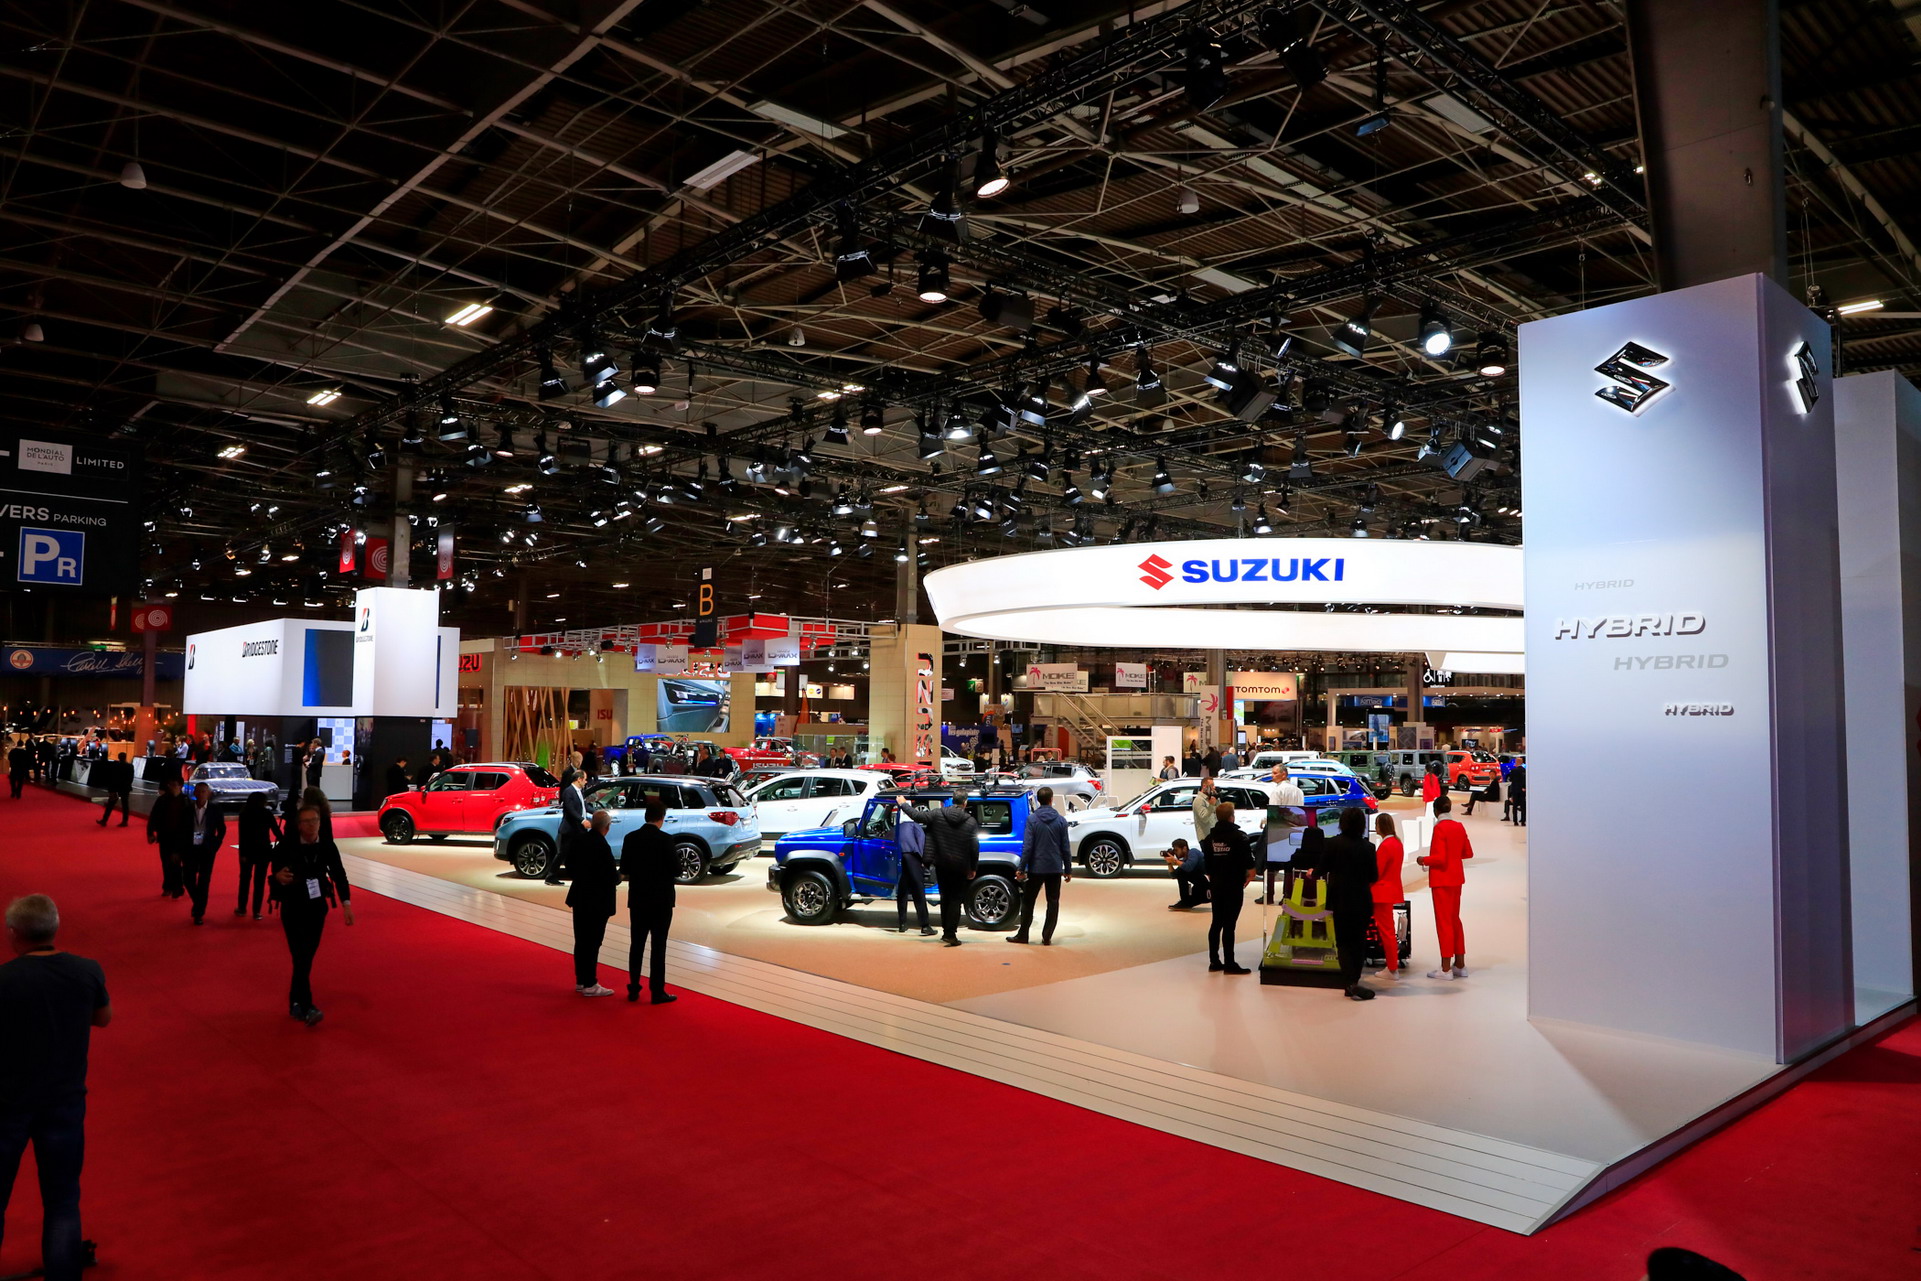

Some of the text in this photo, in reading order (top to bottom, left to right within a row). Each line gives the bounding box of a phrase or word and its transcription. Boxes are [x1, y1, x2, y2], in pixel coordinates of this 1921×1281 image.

[27, 447, 64, 456] MONDIAL
[76, 456, 125, 470] LIMITED
[53, 513, 107, 527] PARKING
[1182, 558, 1345, 583] SUZUKI
[1574, 579, 1635, 591] HYBRID
[699, 583, 714, 616] B
[1555, 609, 1707, 640] HYBRID
[242, 640, 279, 658] BRIDGESTONE
[1614, 654, 1729, 671] HYBRID
[1042, 672, 1075, 680] MOKE
[1664, 701, 1735, 717] HYBRID
